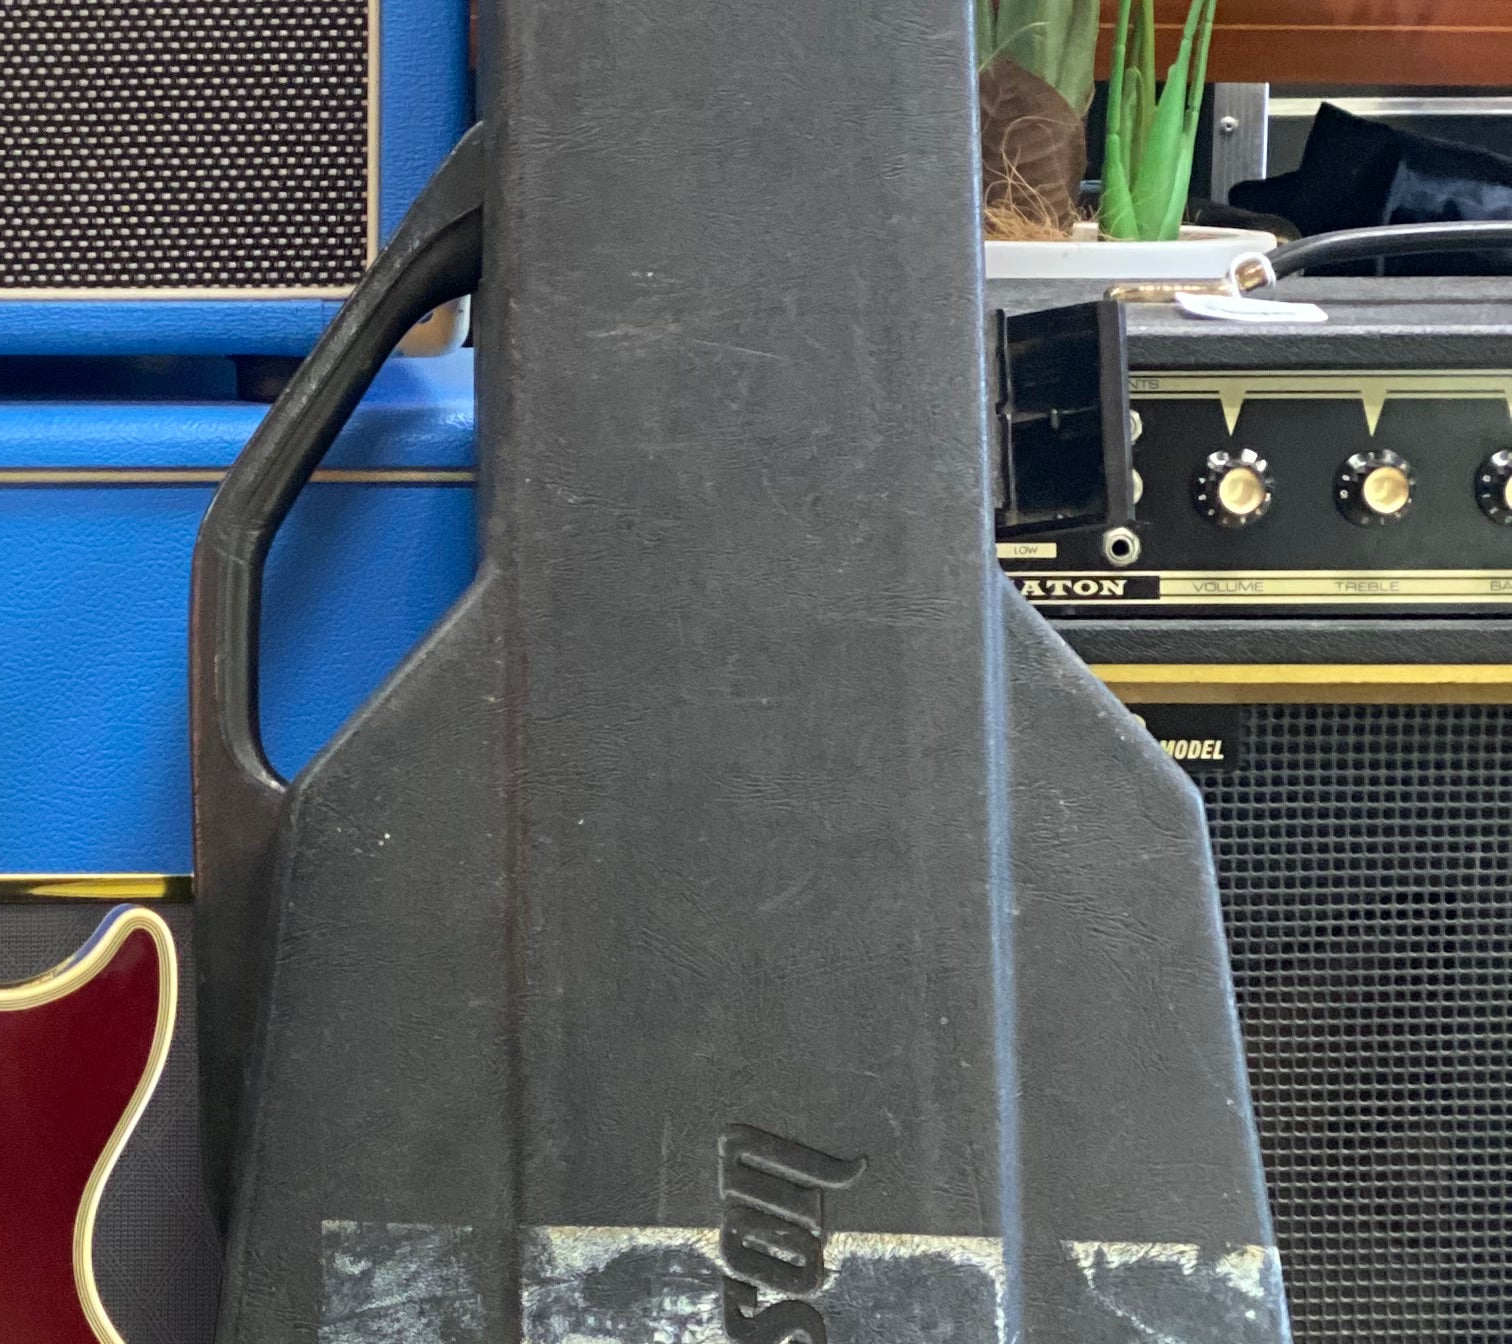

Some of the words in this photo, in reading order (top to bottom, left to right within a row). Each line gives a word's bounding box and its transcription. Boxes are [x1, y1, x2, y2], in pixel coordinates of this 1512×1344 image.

[1013, 545, 1039, 555] LOW
[1012, 578, 1129, 597] ATON
[1193, 581, 1265, 593] VOLUME
[1335, 580, 1400, 592] TREBLE
[1160, 739, 1225, 760] MODEL
